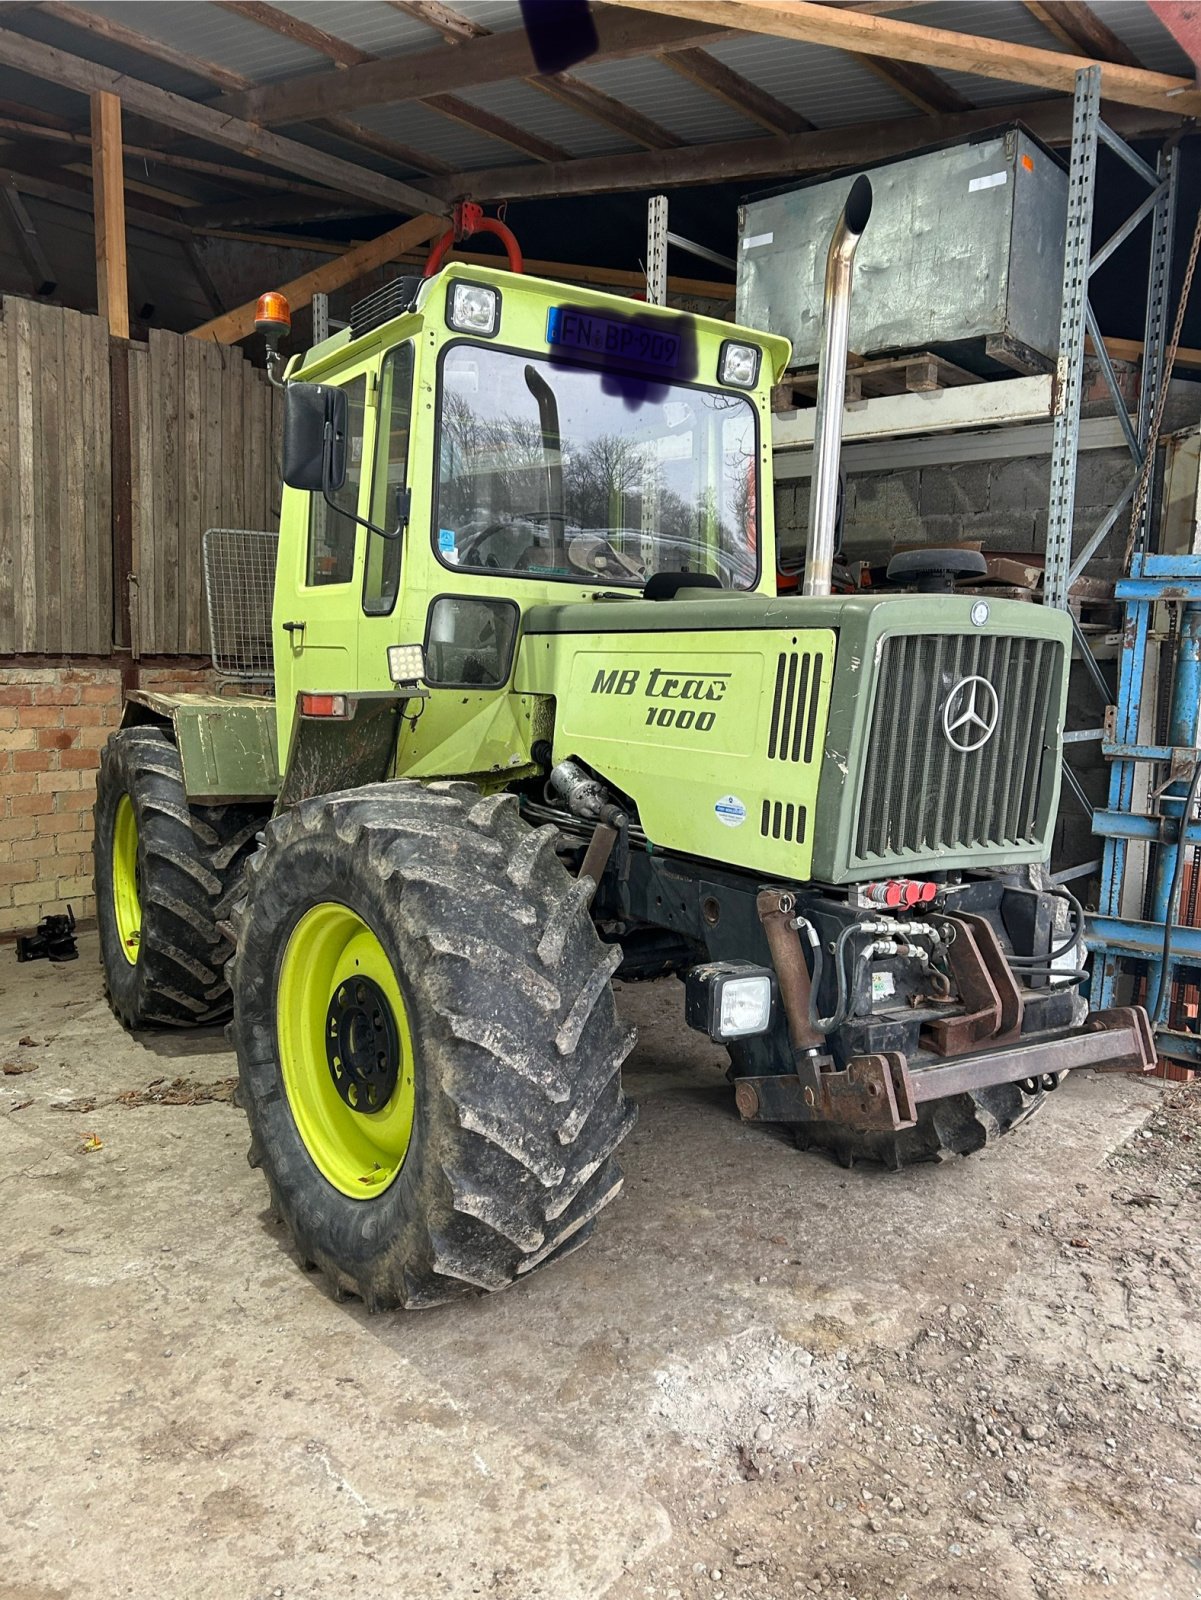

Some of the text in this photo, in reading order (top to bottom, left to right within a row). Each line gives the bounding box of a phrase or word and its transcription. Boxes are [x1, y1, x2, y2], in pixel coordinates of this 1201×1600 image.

[562, 316, 592, 346] FN
[590, 668, 732, 700] MB trac
[645, 707, 716, 731] 1000
